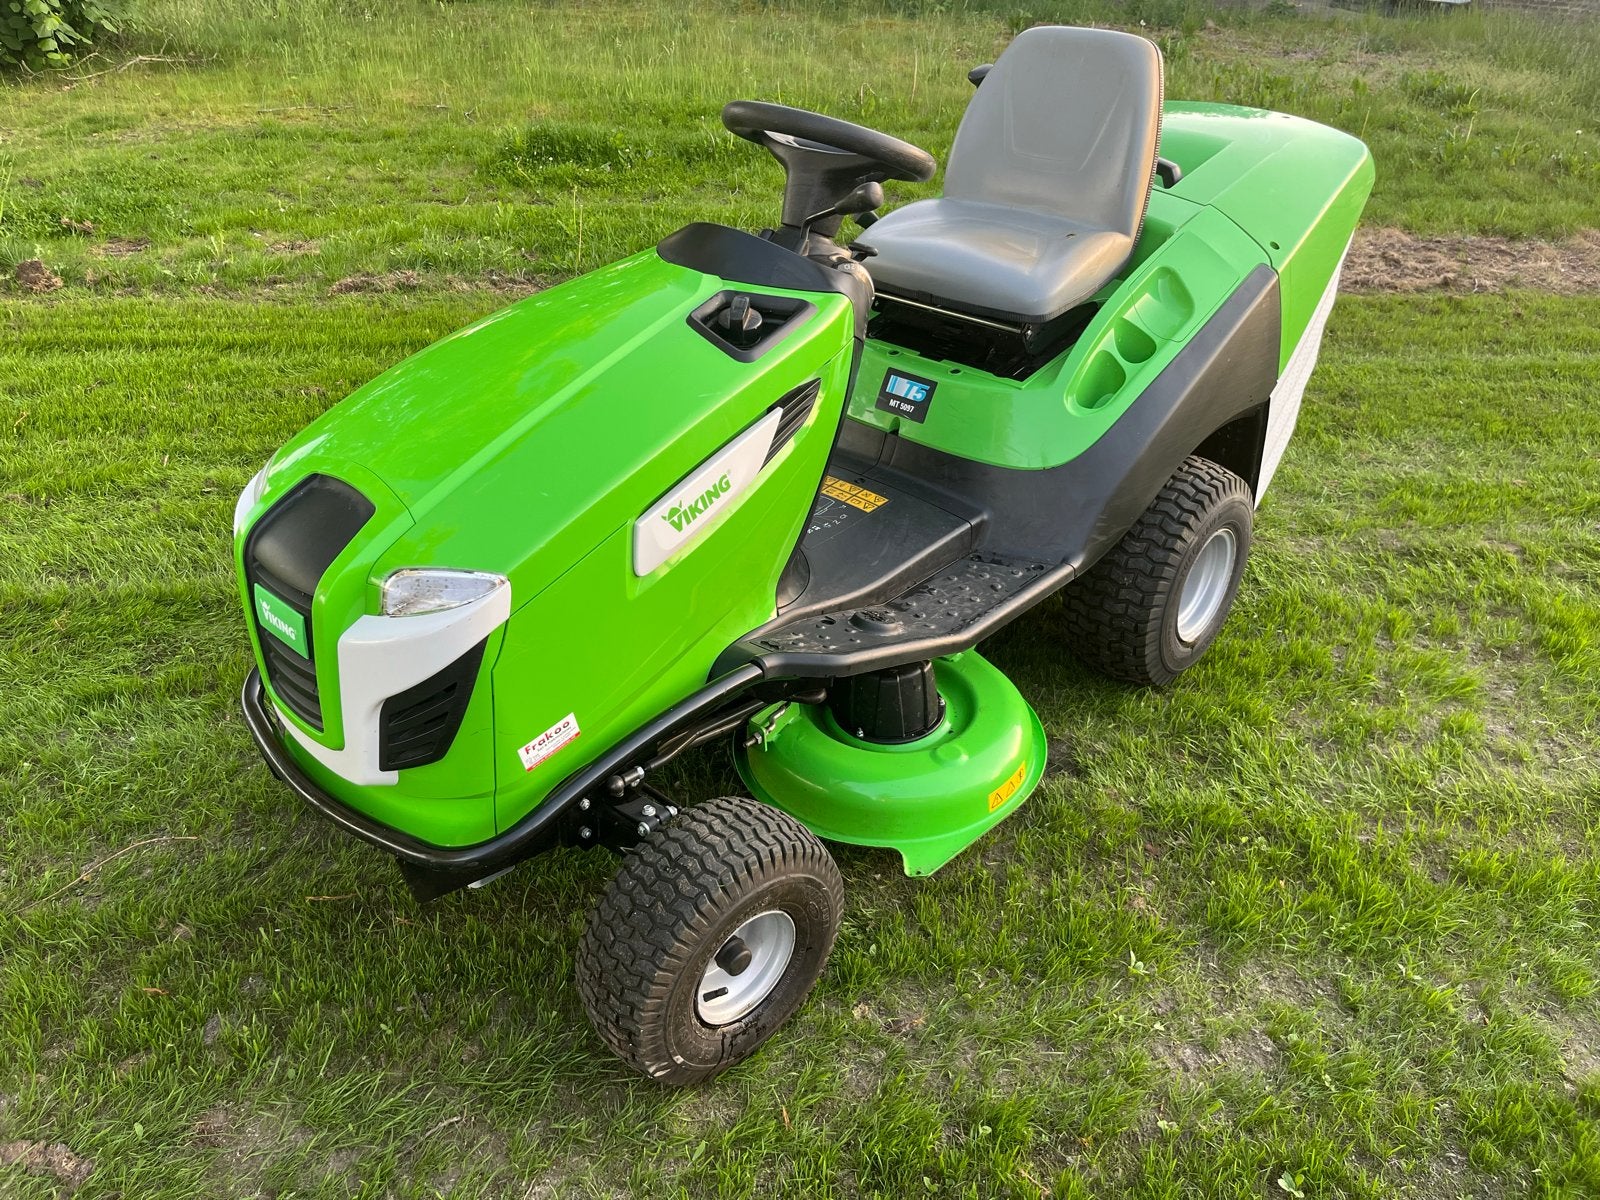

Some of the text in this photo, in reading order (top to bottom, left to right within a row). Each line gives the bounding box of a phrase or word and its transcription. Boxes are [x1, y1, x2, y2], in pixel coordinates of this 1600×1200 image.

[889, 398, 915, 413] MT 5097
[668, 473, 732, 533] VIKING
[262, 606, 296, 641] VIKING
[524, 720, 570, 755] Frakoo
